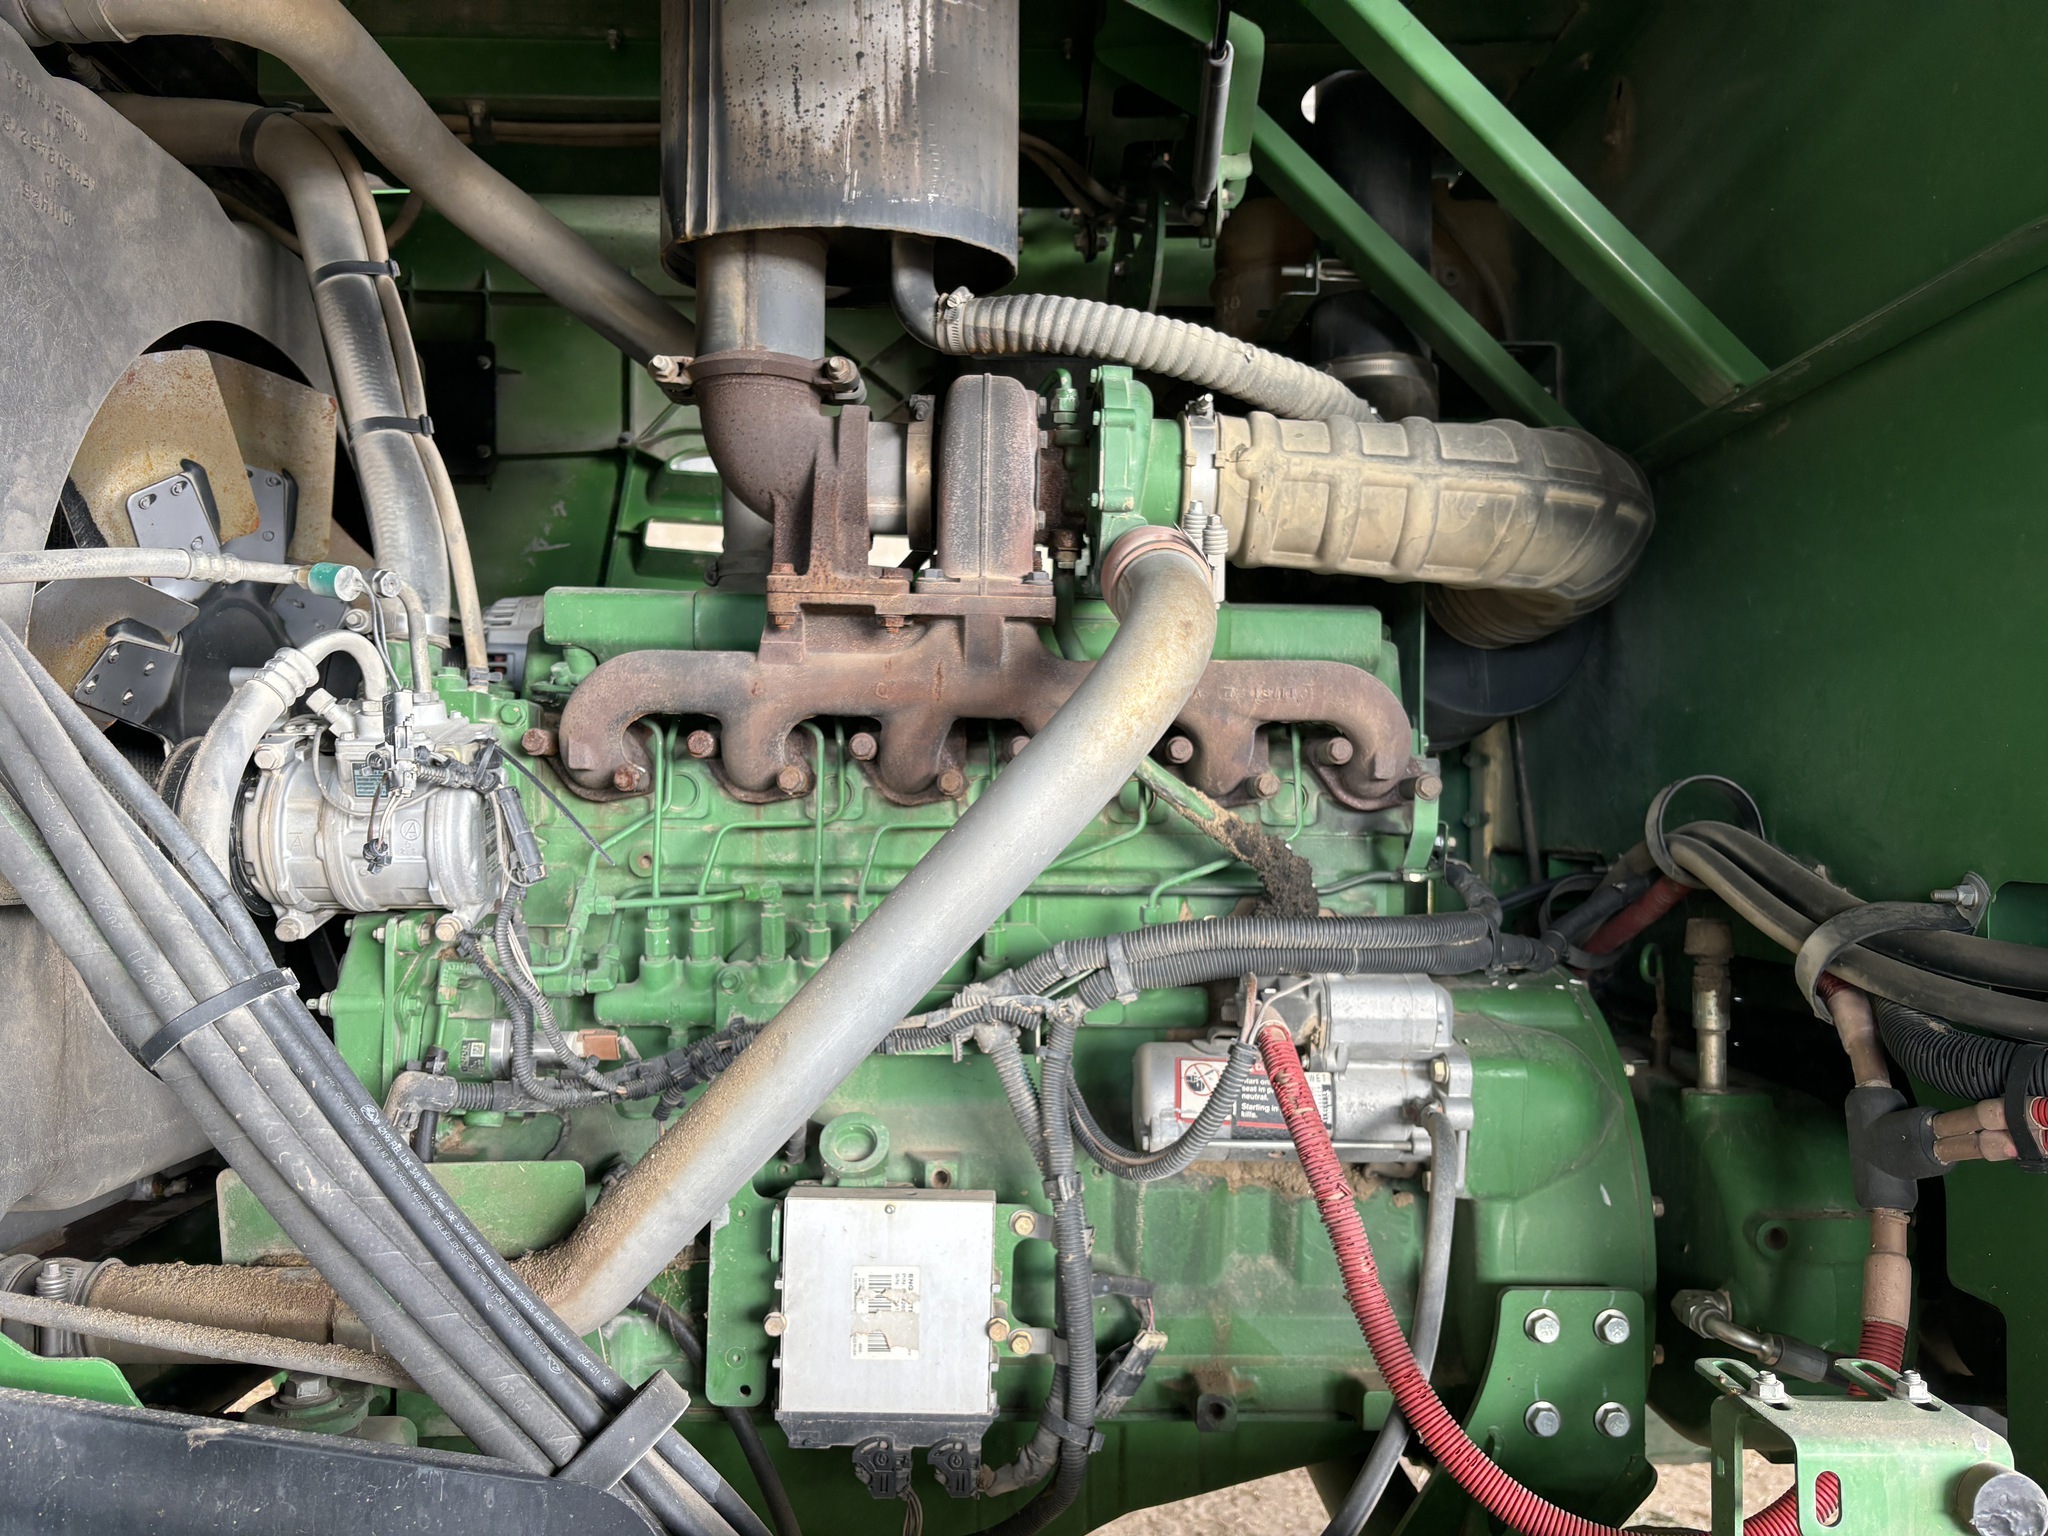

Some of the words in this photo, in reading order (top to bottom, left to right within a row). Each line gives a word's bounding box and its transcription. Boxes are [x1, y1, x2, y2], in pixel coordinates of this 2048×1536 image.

[1241, 1102, 1271, 1113] Starting
[396, 1169, 414, 1191] SYSTEMS
[432, 1217, 443, 1230] FUEL
[388, 1139, 403, 1154] FUEL
[399, 1153, 413, 1167] LINE
[410, 1167, 421, 1178] 3/8
[419, 1177, 431, 1191] INCH
[445, 1210, 457, 1222] SAE
[465, 1233, 476, 1245] NOT
[474, 1243, 485, 1255] FOR
[482, 1253, 496, 1267] FUEL
[494, 1265, 517, 1293] INJECTION
[516, 1289, 535, 1312] SYSTEMS
[534, 1309, 549, 1324] MADE
[546, 1322, 555, 1331] IN
[442, 1230, 451, 1240] FOR
[450, 1240, 459, 1250] NOT
[468, 1262, 478, 1272] SAE
[503, 1304, 513, 1315] 3/8
[512, 1315, 524, 1327] LINE
[524, 1328, 535, 1339] FUEL
